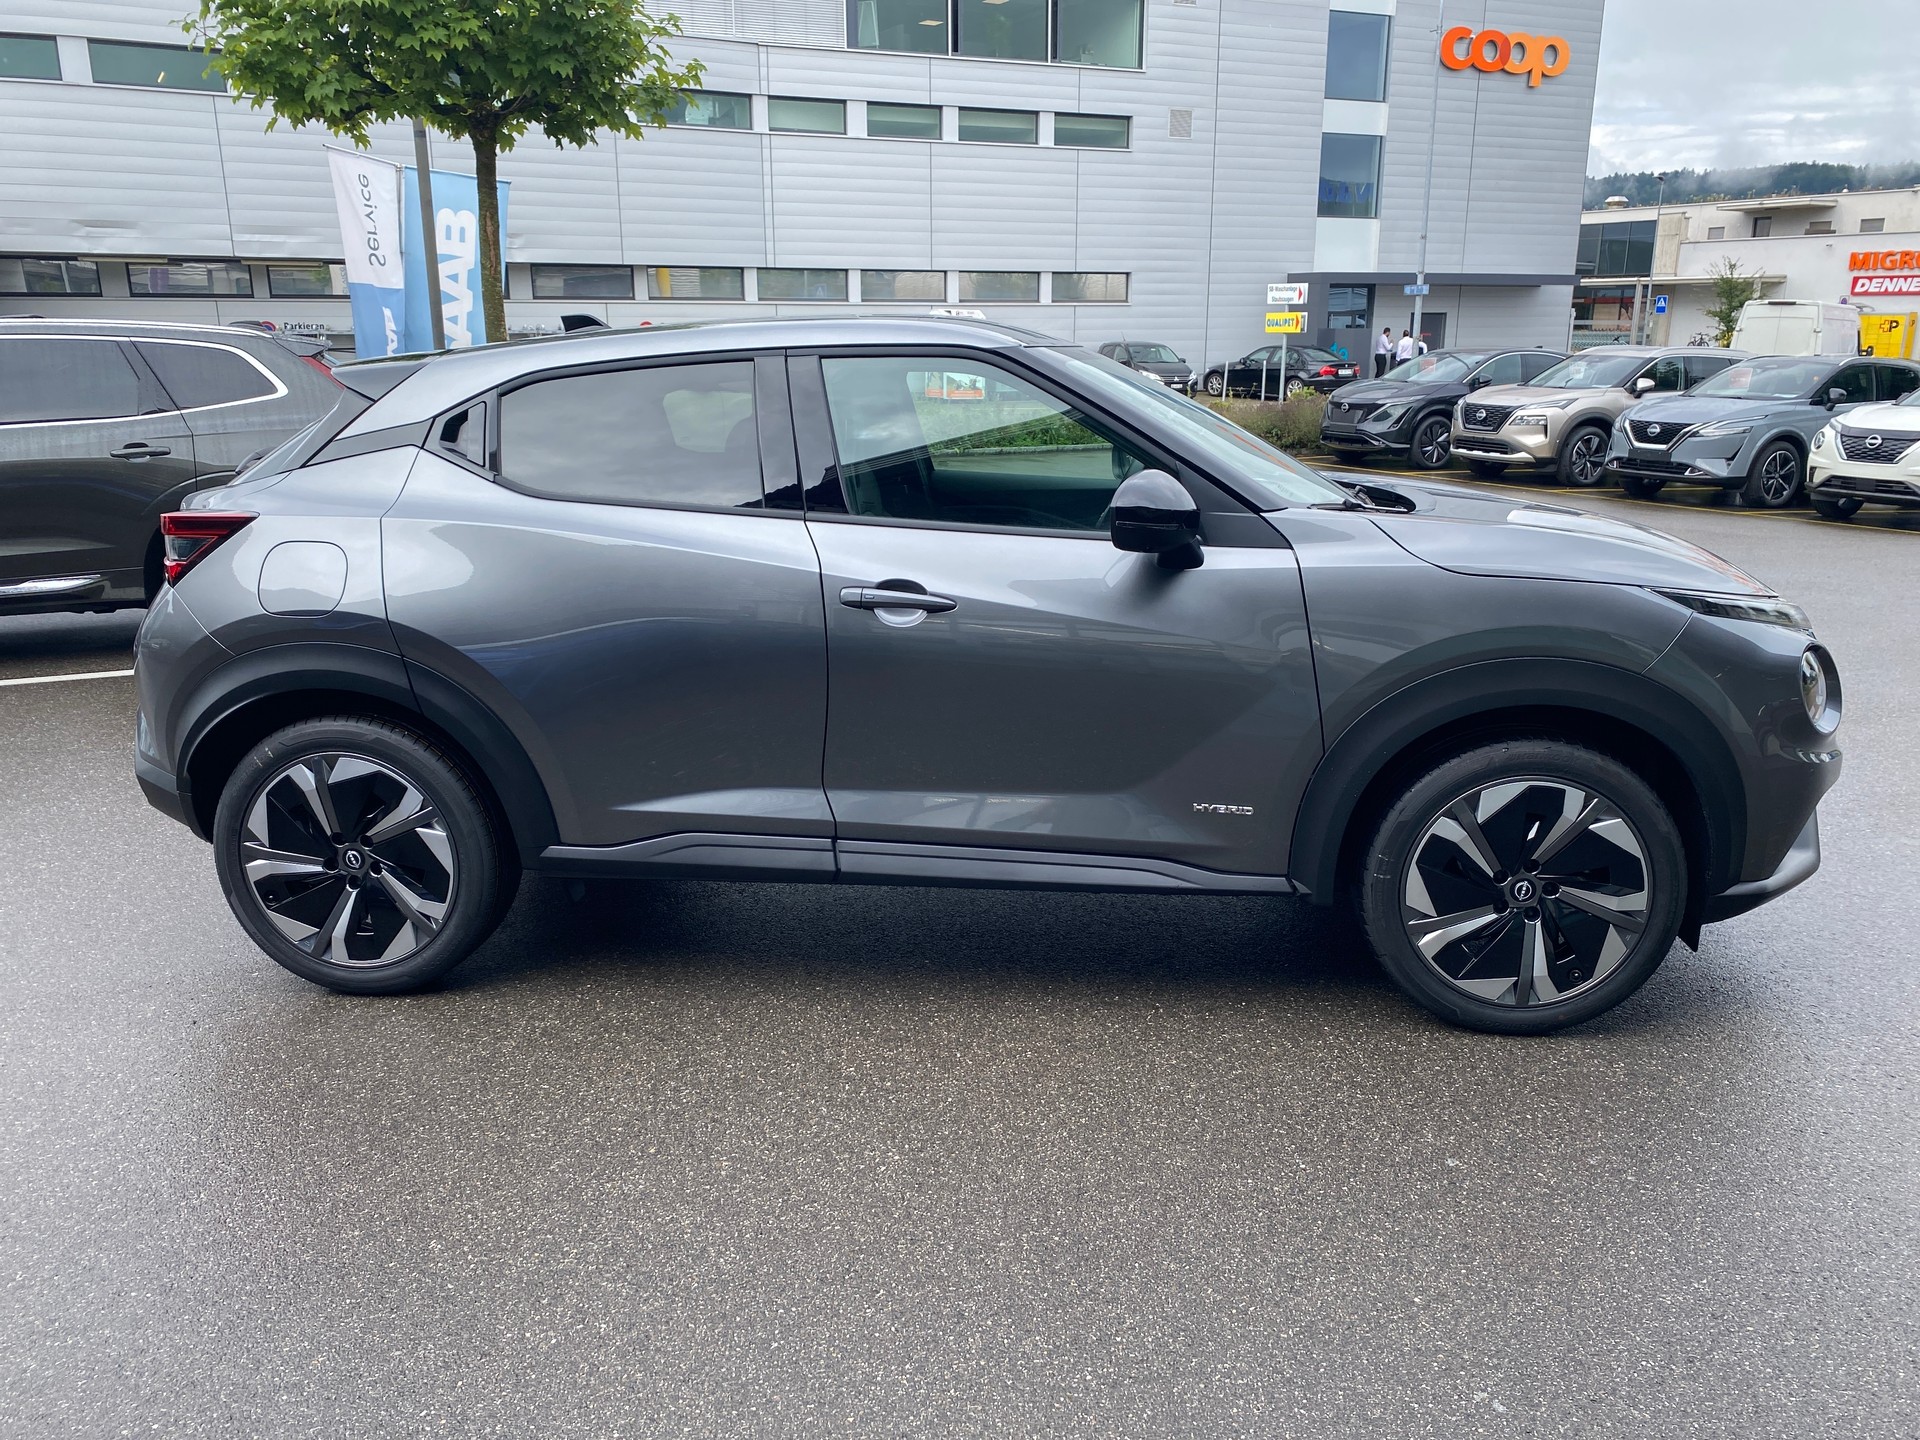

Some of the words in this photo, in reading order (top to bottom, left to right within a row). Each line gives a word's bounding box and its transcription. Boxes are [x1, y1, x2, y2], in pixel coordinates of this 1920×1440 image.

[1440, 26, 1571, 87] coop
[1849, 250, 1920, 271] MIGR
[436, 207, 477, 349] AAB
[283, 322, 325, 330] Parkieren
[1267, 318, 1294, 327] QUALIPET
[1192, 803, 1255, 815] HYBRID
